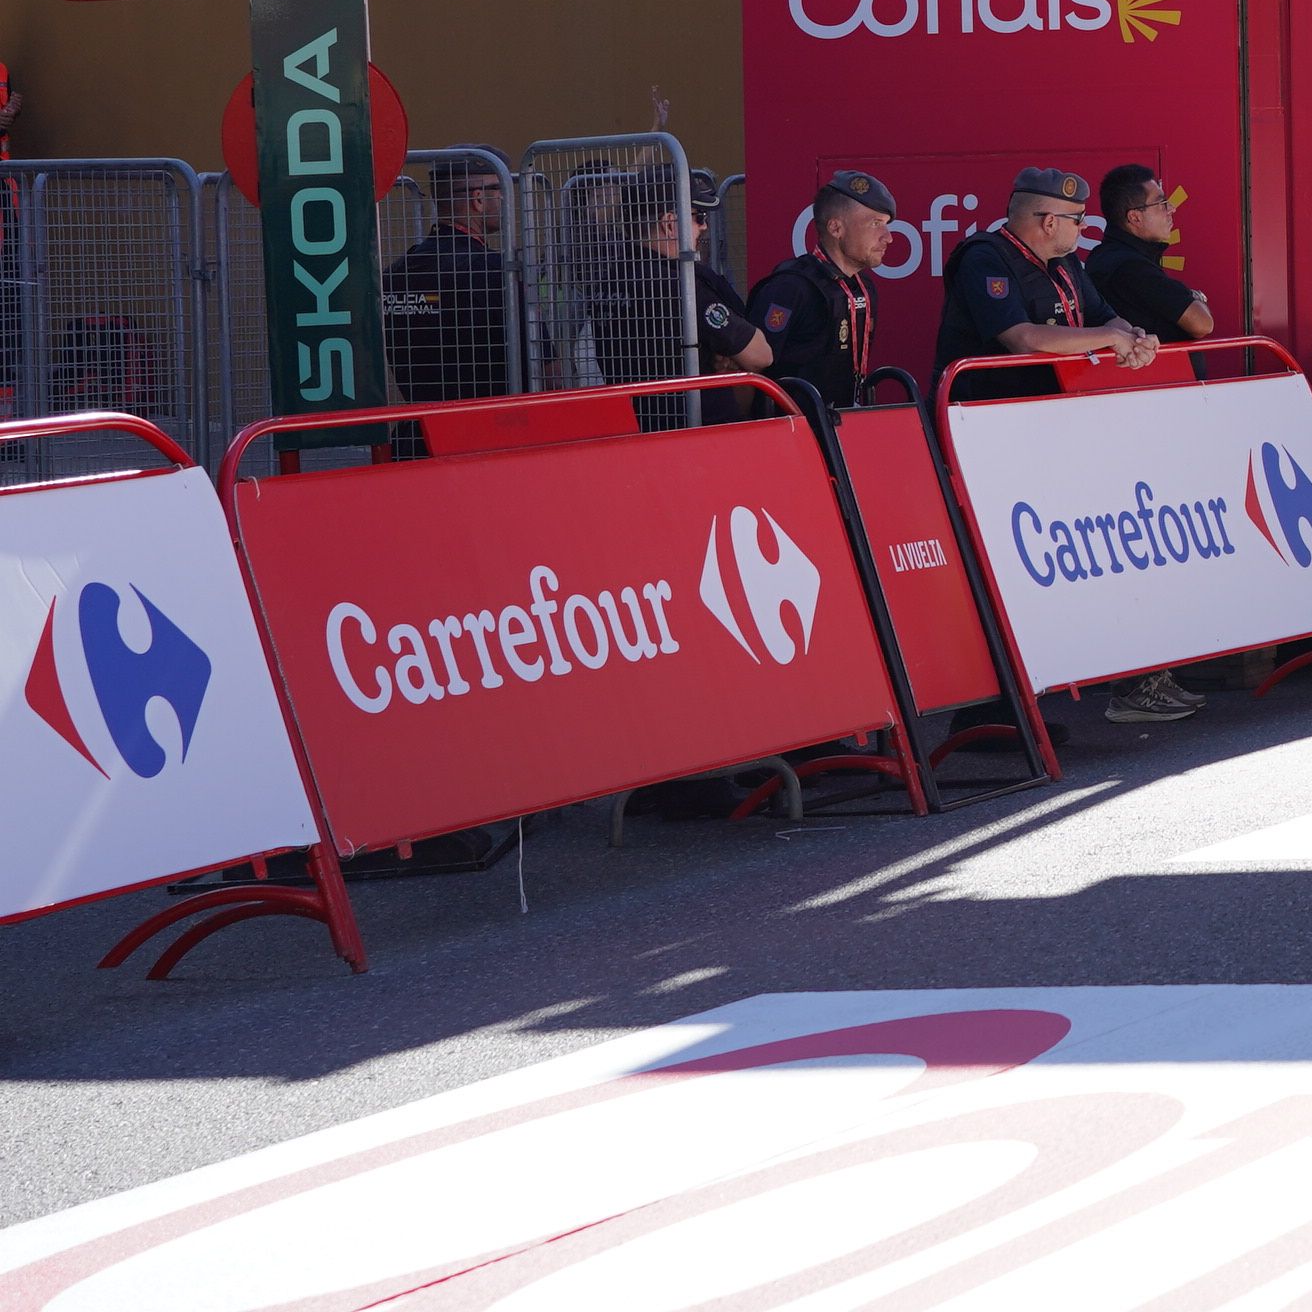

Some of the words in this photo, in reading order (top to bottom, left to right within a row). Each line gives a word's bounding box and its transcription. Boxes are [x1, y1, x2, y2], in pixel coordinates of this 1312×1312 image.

[889, 544, 909, 573] LA
[907, 538, 947, 570] VUELTA
[1011, 481, 1236, 587] Carrefour
[325, 564, 681, 714] Carrefour
